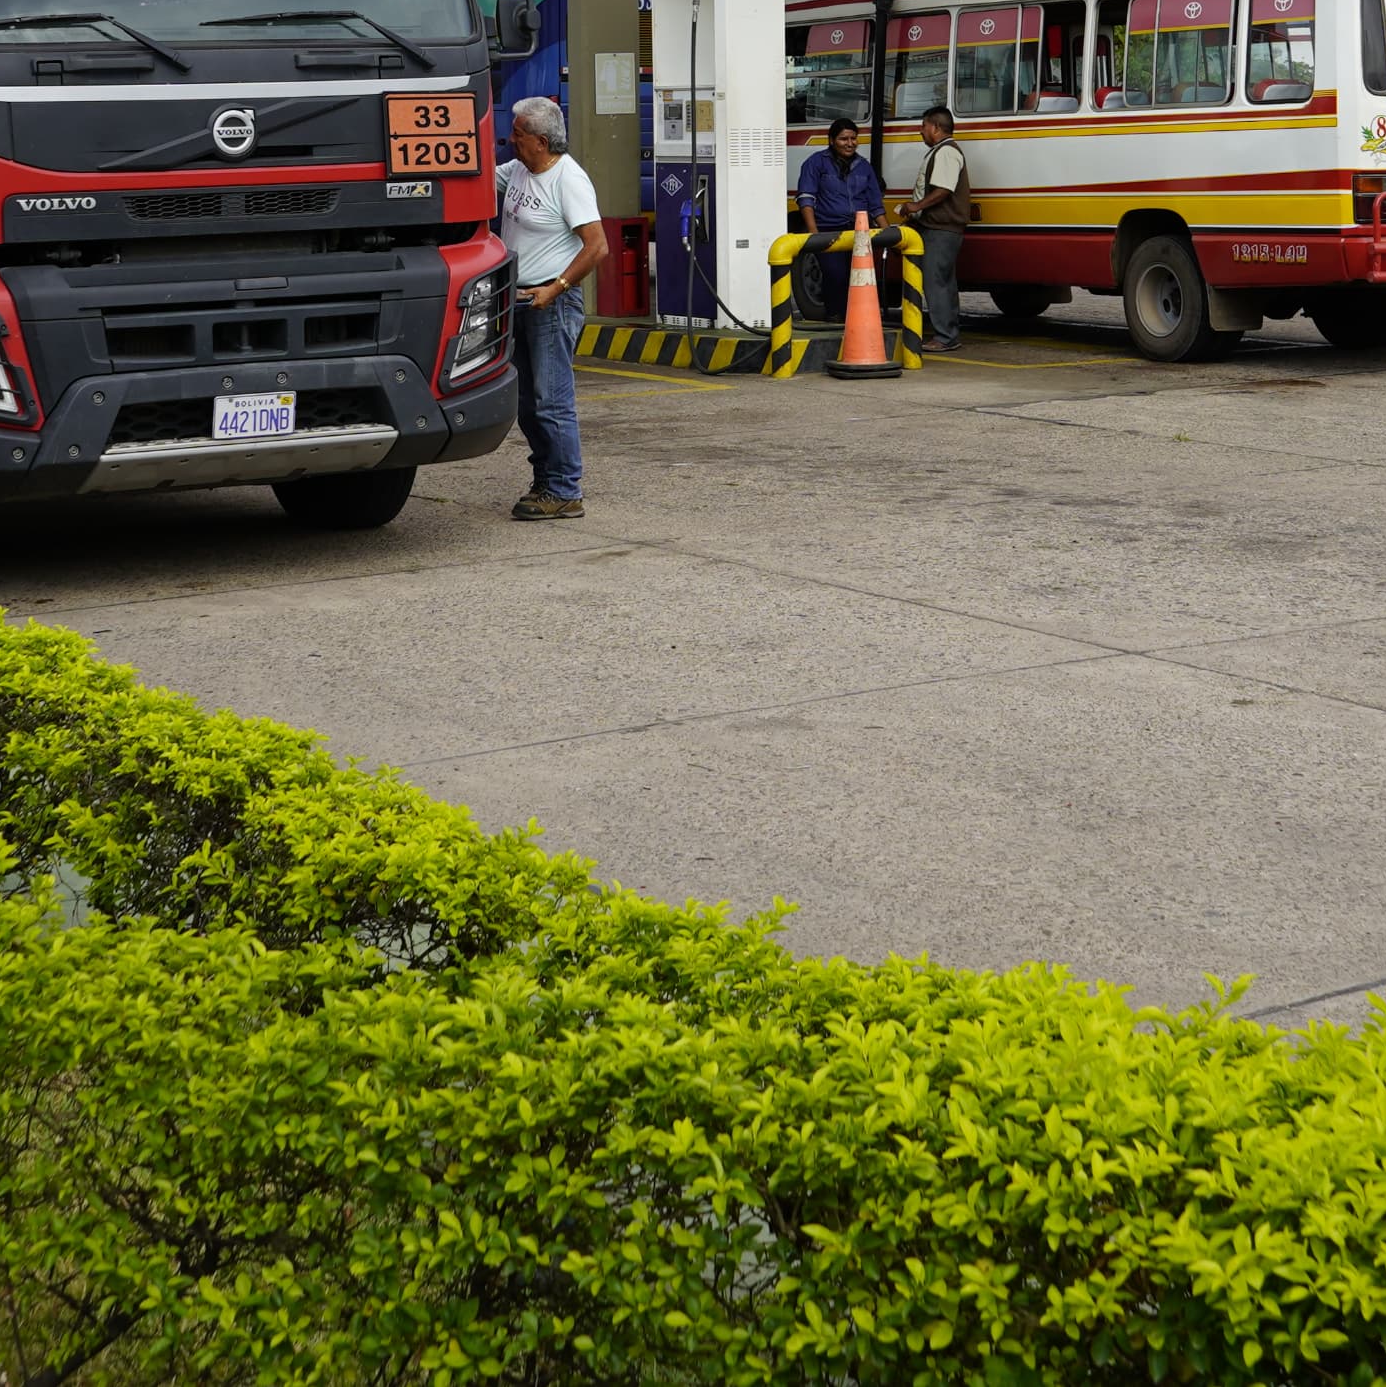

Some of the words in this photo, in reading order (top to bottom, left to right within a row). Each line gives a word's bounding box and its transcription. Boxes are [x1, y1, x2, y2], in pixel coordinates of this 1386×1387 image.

[414, 105, 450, 128] 33
[1377, 116, 1386, 138] 8
[216, 128, 253, 136] VOLVO
[398, 142, 470, 166] 1203
[16, 197, 97, 211] VOLVO
[507, 185, 542, 211] GUESS
[234, 399, 275, 408] BOLIVIA
[219, 407, 290, 434] 4421DNB
